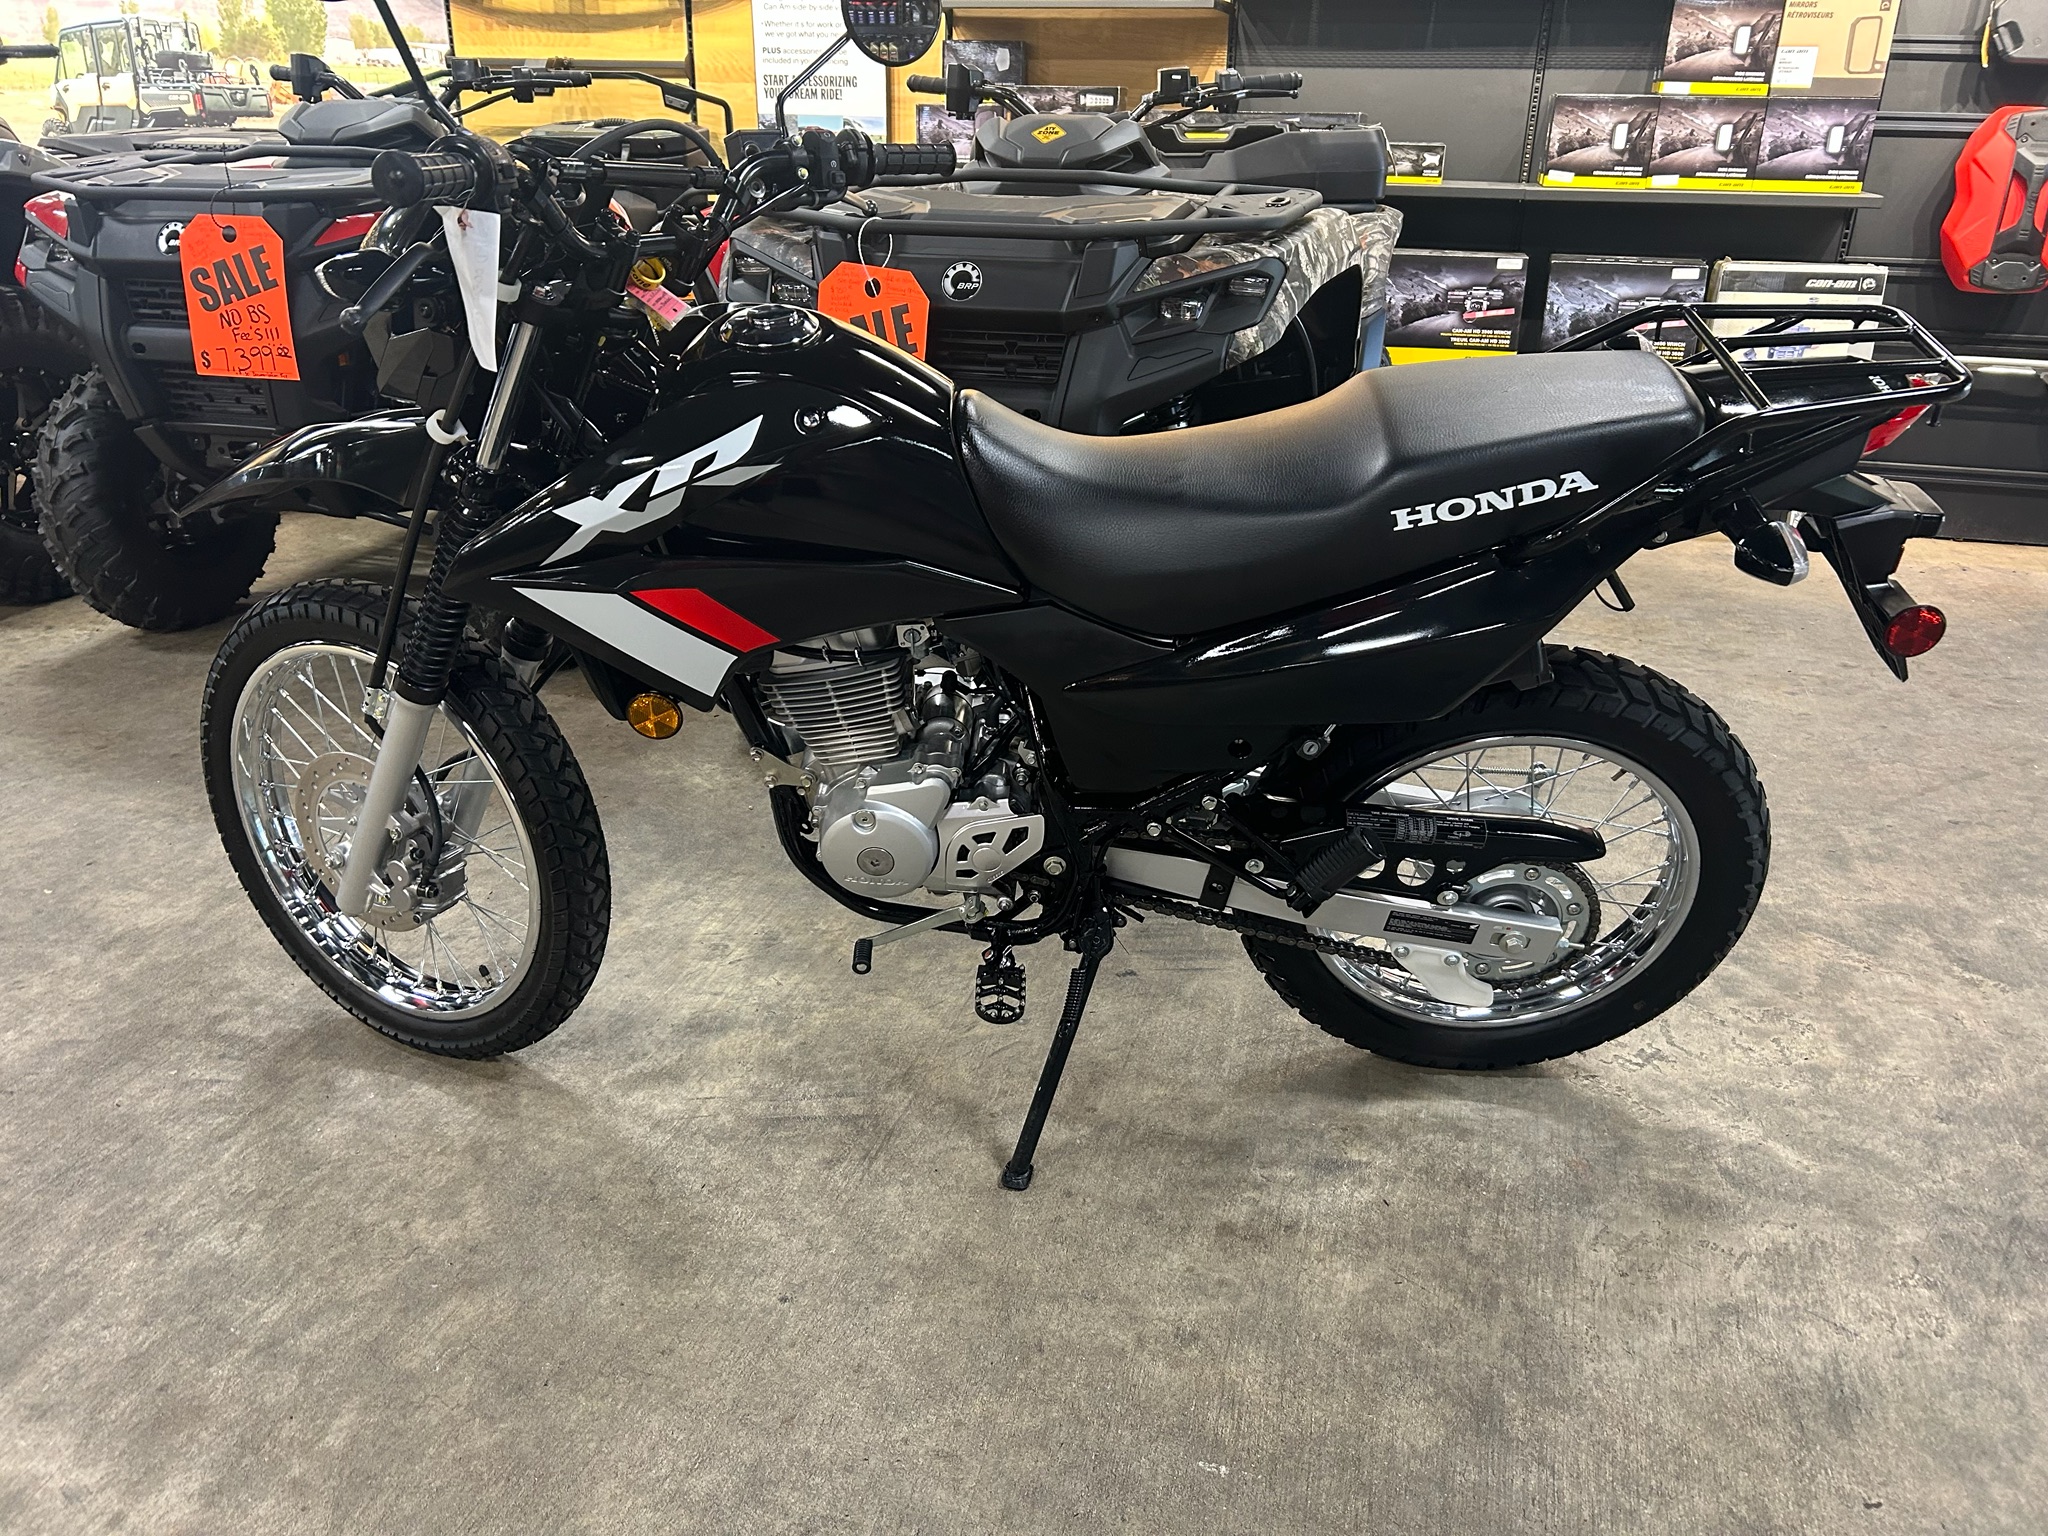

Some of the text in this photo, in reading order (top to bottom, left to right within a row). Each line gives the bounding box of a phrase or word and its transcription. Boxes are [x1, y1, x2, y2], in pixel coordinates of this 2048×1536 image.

[1787, 11, 1834, 19] RÉTROVISEURS
[765, 20, 793, 28] Whether
[763, 74, 789, 86] START
[821, 89, 843, 100] RIDE!
[190, 245, 279, 312] SALE
[957, 282, 980, 290] BRP
[219, 303, 271, 329] NO BS
[1390, 470, 1599, 531] HONDA
